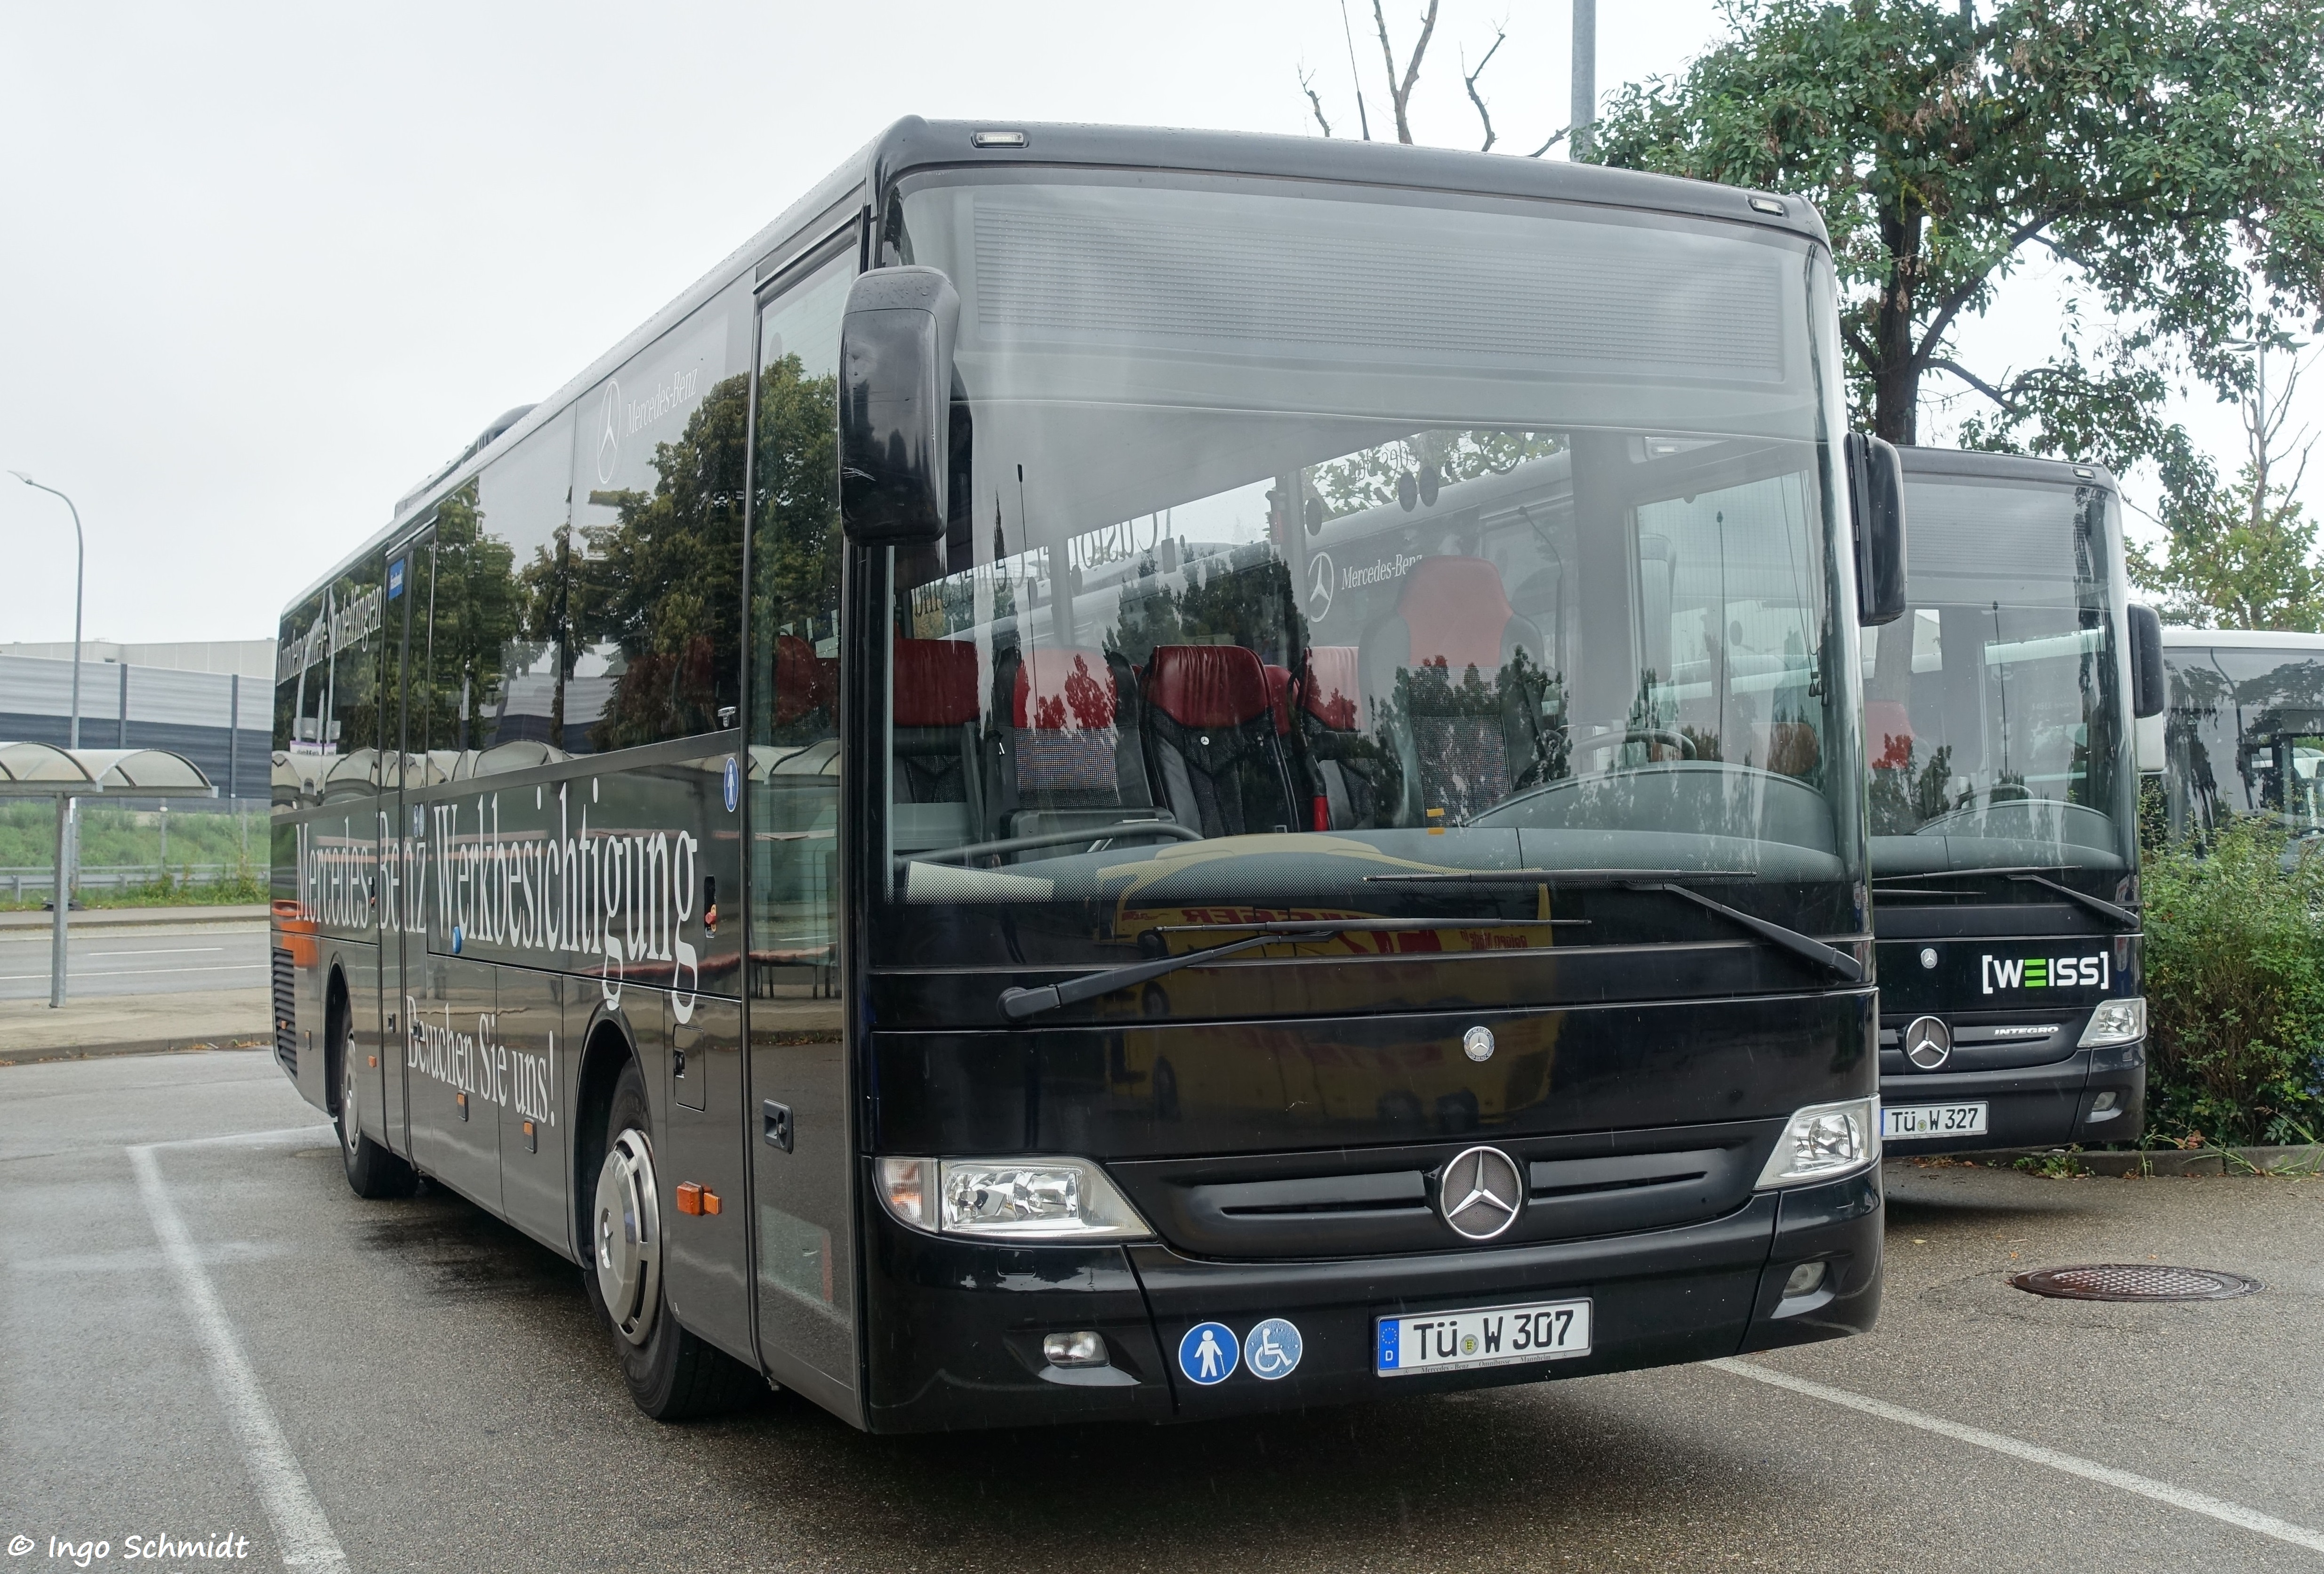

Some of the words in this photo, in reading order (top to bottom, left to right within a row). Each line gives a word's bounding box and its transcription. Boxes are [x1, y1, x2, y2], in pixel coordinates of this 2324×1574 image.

[626, 368, 698, 437] Mercedes-Benz
[296, 811, 426, 934] Mercedes-Benz
[434, 777, 697, 1024] Werkbesichtigung
[1468, 1028, 1490, 1038] MERCEDES
[1994, 1026, 2059, 1036] INTEGRO
[406, 995, 475, 1093] Besuchen
[479, 1013, 507, 1107] Sie
[512, 1030, 555, 1127] uns!
[1891, 1111, 1915, 1132] TÜ
[1929, 1110, 1940, 1130] W
[1945, 1107, 1978, 1130] 327
[1413, 1321, 1457, 1360] TÜ
[1483, 1316, 1504, 1353] W
[1512, 1309, 1574, 1349] 307
[1385, 1350, 1393, 1361] D
[1479, 1359, 1511, 1367] Omnibusse
[1520, 1355, 1551, 1363] Mannheim
